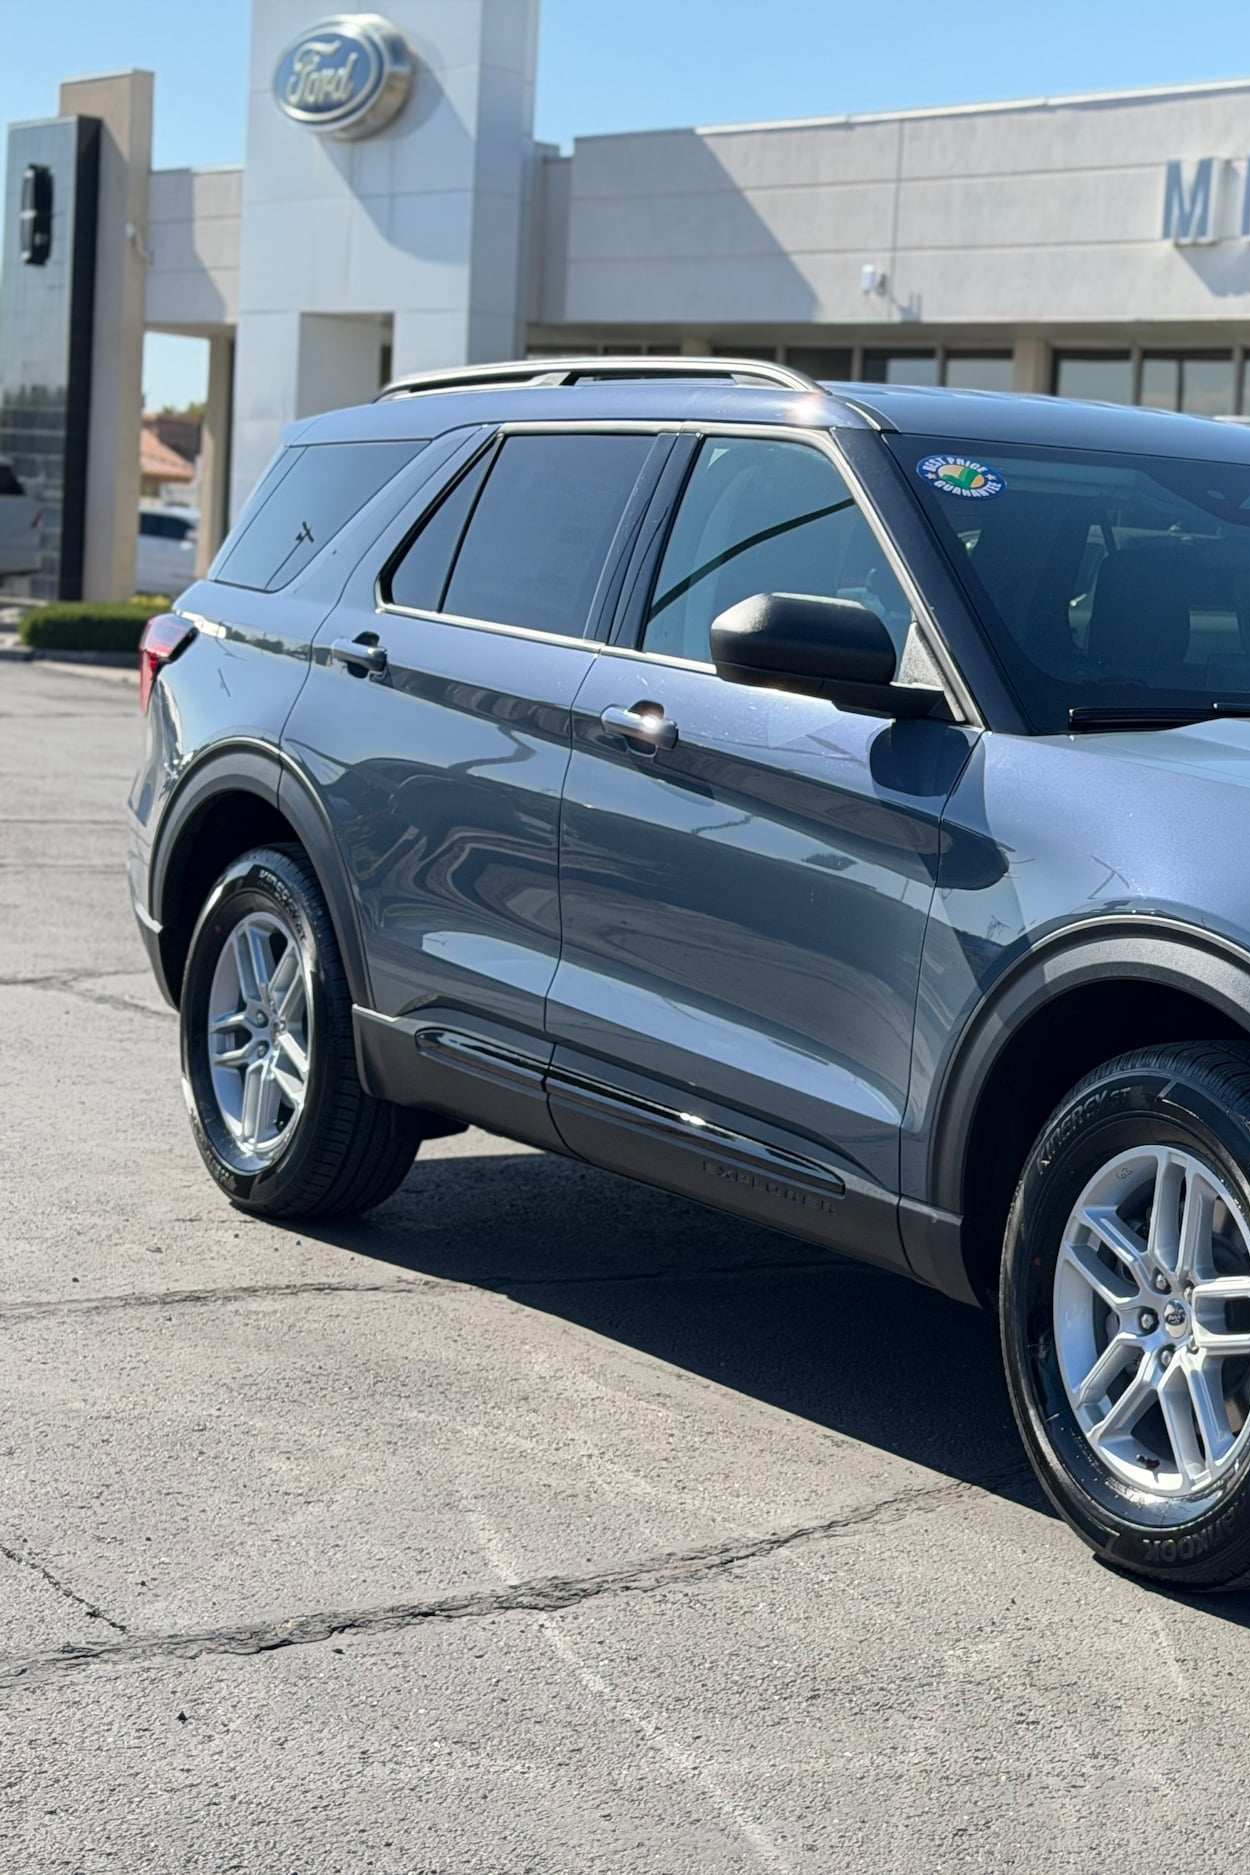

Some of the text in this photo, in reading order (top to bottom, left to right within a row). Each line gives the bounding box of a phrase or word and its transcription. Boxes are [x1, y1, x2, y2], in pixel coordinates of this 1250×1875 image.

[286, 40, 359, 106] Ford
[922, 456, 988, 474] BEST PRICE
[933, 479, 1002, 498] GUARANTEE
